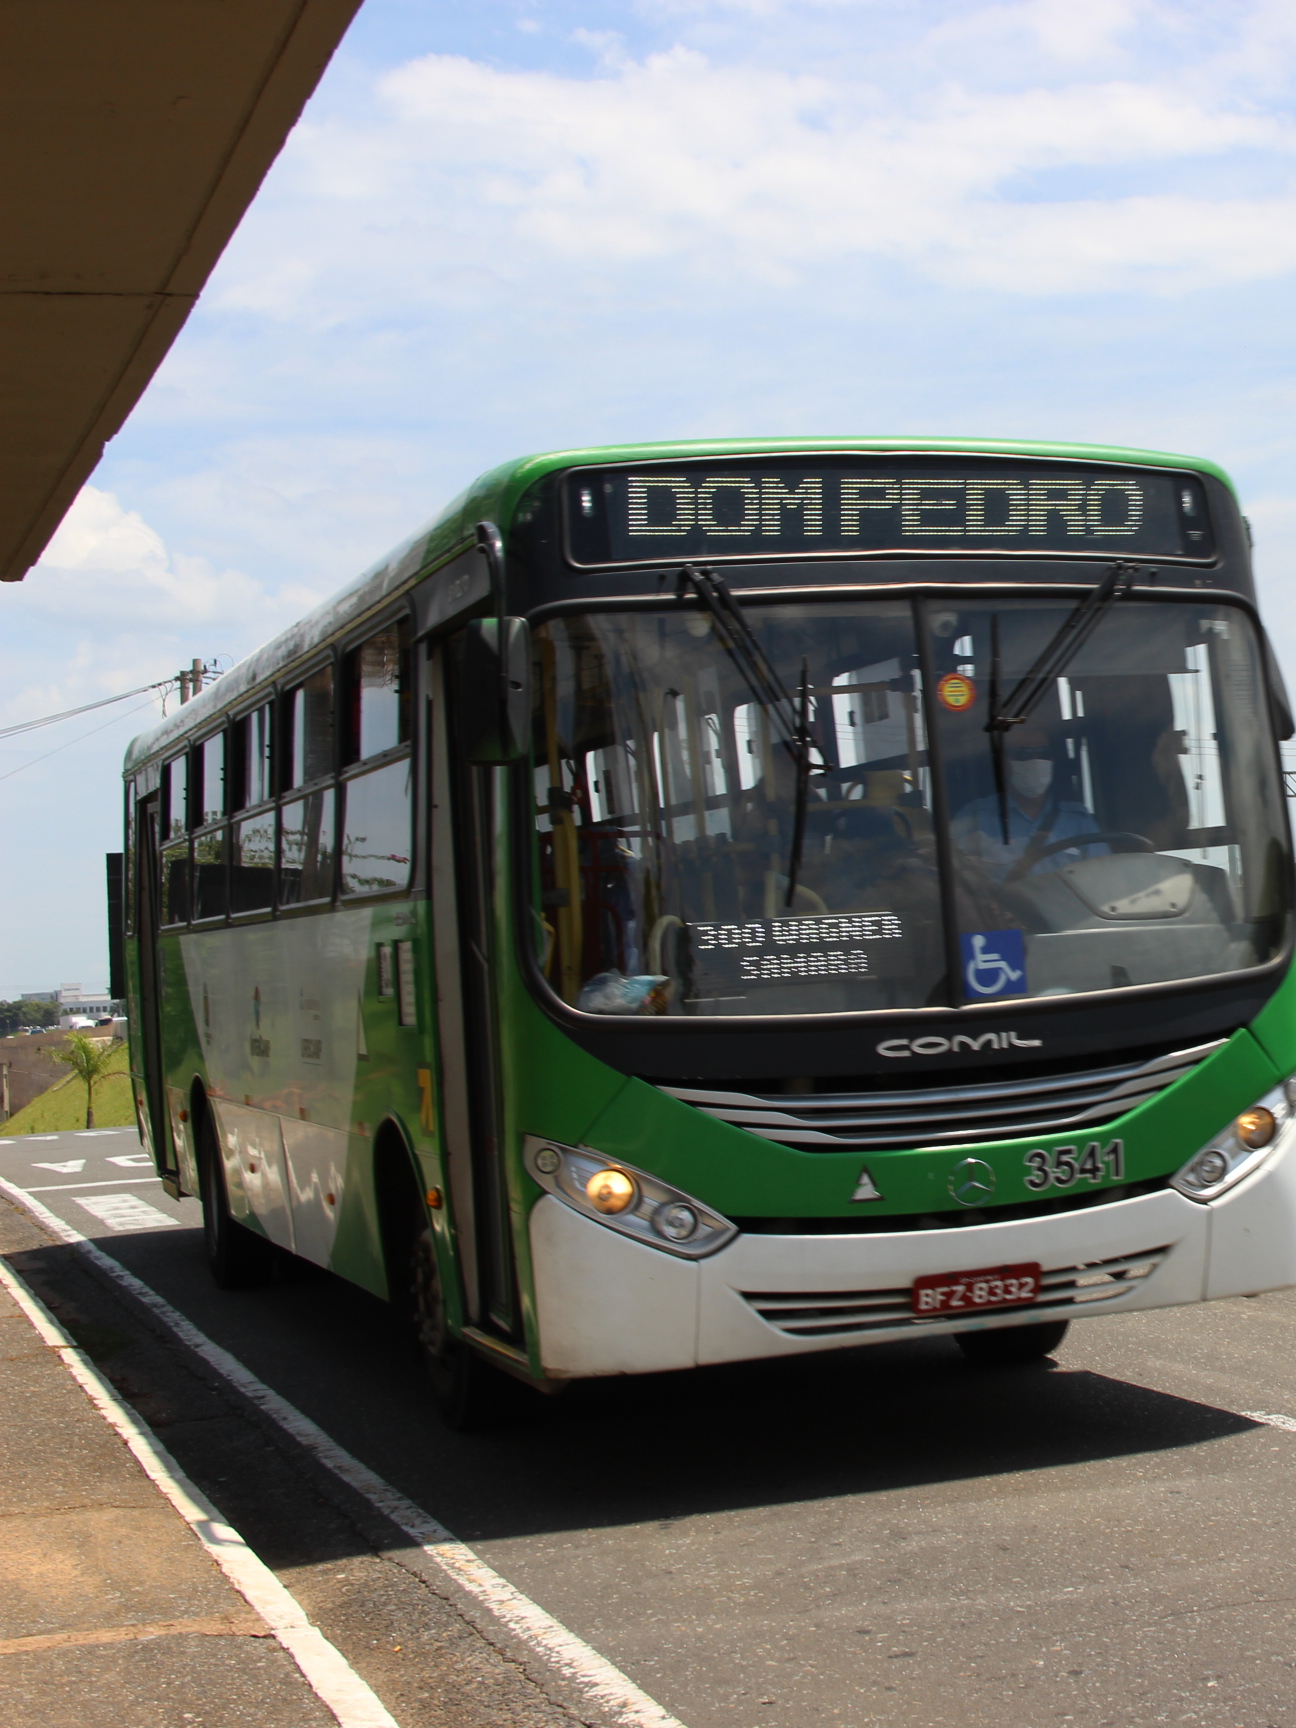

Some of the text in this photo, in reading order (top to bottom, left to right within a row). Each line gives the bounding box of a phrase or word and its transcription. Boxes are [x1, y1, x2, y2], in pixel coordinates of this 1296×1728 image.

[627, 476, 1144, 537] DOM PEDRO
[697, 915, 903, 950] 300 WAGNER
[876, 1030, 1043, 1057] COMIL
[1022, 1138, 1126, 1192] 3541
